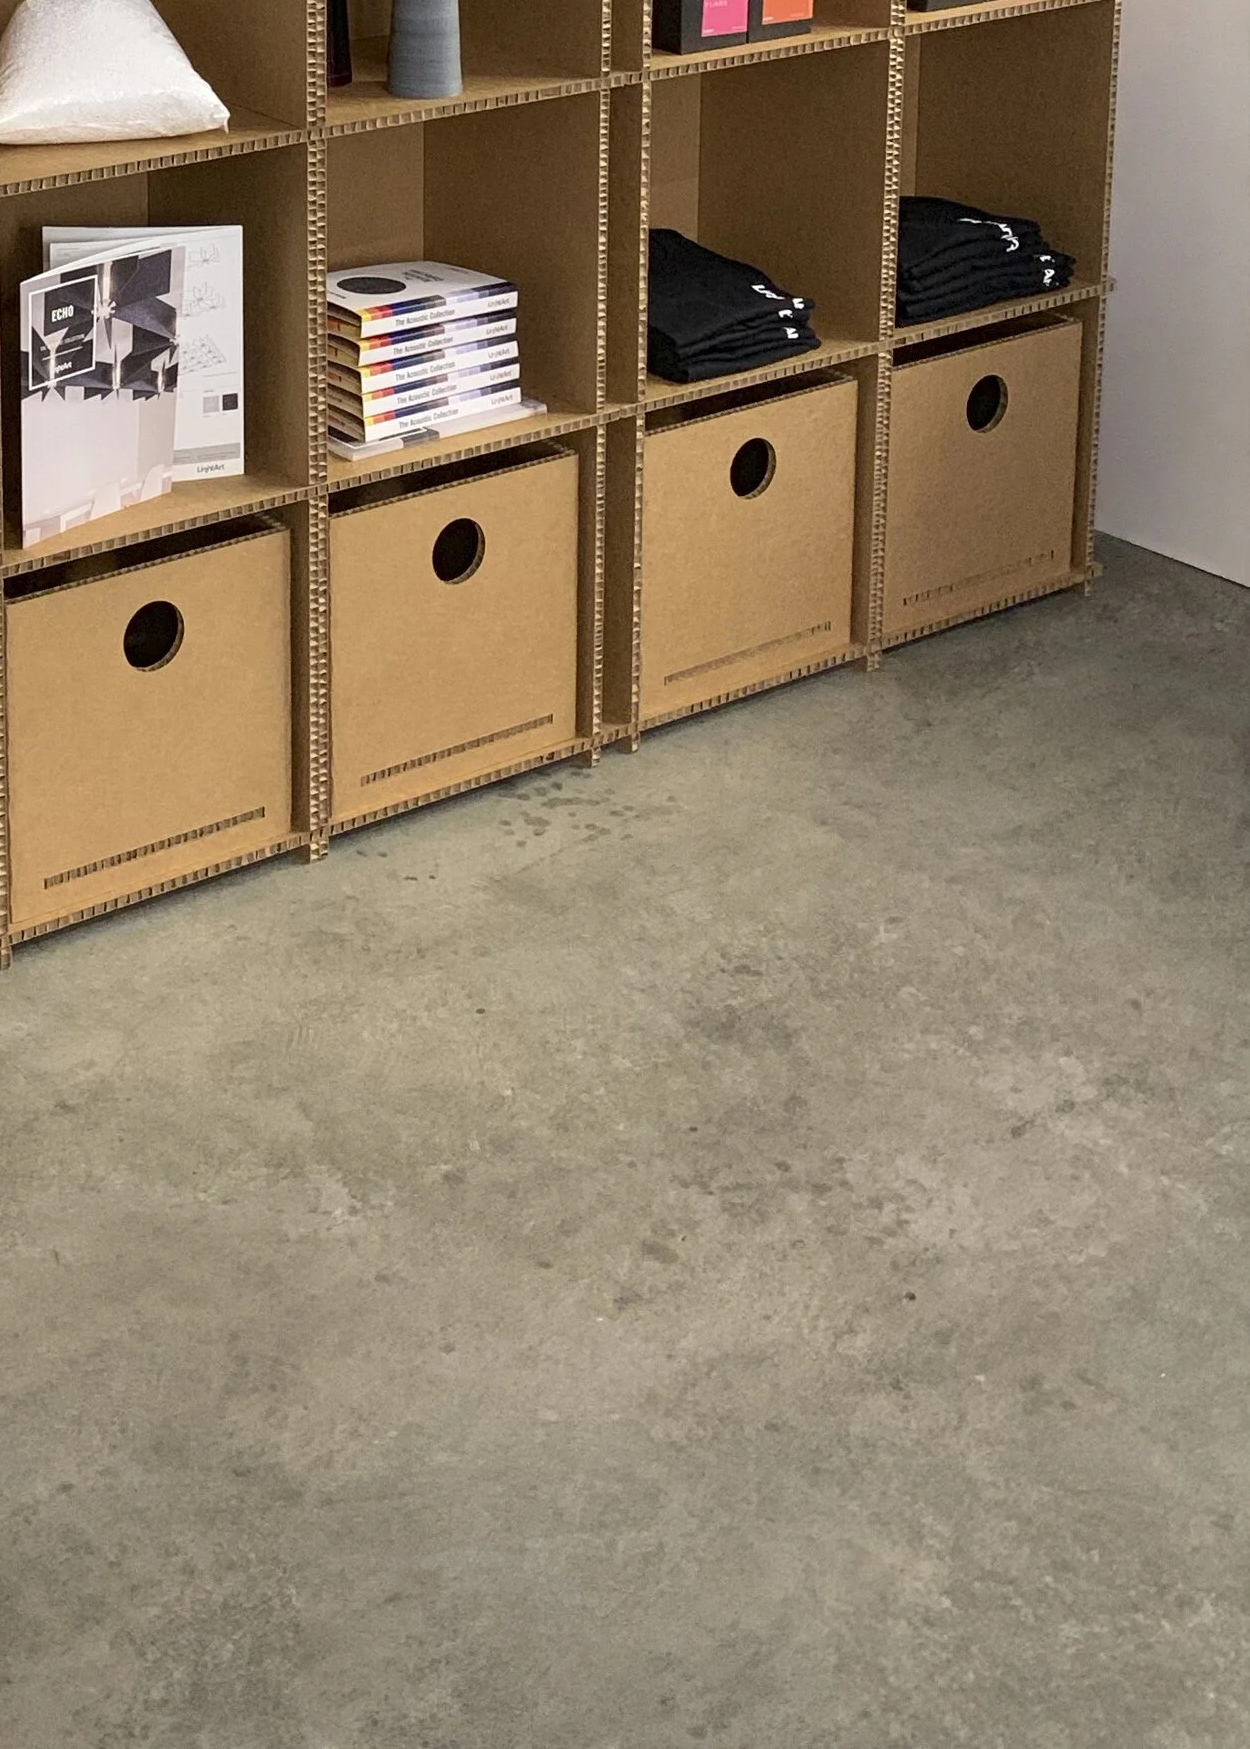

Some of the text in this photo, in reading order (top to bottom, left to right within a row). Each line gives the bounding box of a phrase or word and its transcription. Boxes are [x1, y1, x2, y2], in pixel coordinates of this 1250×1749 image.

[51, 304, 74, 323] ECHO
[395, 318, 405, 326] The
[430, 309, 455, 320] Collection
[393, 347, 403, 355] The
[427, 337, 453, 348] Collection
[395, 373, 405, 381] The
[430, 362, 455, 373] Collection
[397, 397, 407, 405] The
[431, 385, 457, 396] Collection
[399, 420, 408, 429] The
[433, 408, 458, 420] Collection
[196, 463, 225, 474] LightArt
